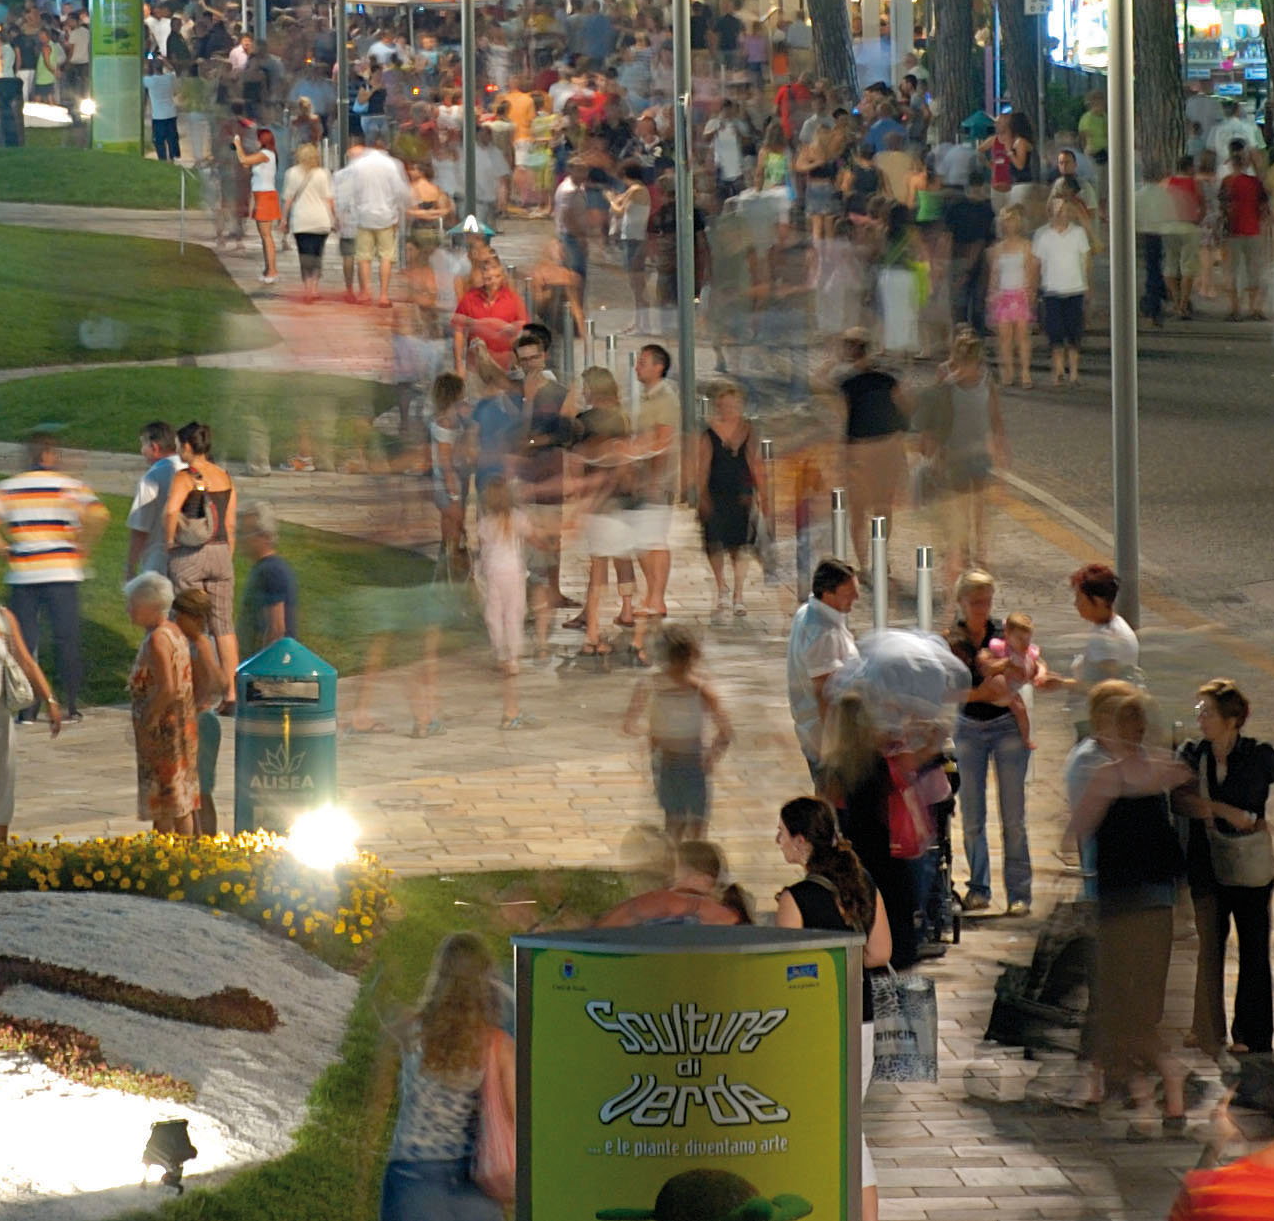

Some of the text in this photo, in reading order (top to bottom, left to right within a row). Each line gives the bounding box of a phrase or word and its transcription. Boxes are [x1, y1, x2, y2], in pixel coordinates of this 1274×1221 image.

[249, 774, 315, 790] ALISEA
[585, 1000, 789, 1055] Sculture
[676, 1058, 701, 1078] di
[605, 1140, 613, 1155] e
[616, 1137, 630, 1156] le
[634, 1137, 680, 1158] piante
[684, 1137, 756, 1157] diventano
[760, 1135, 788, 1154] arte
